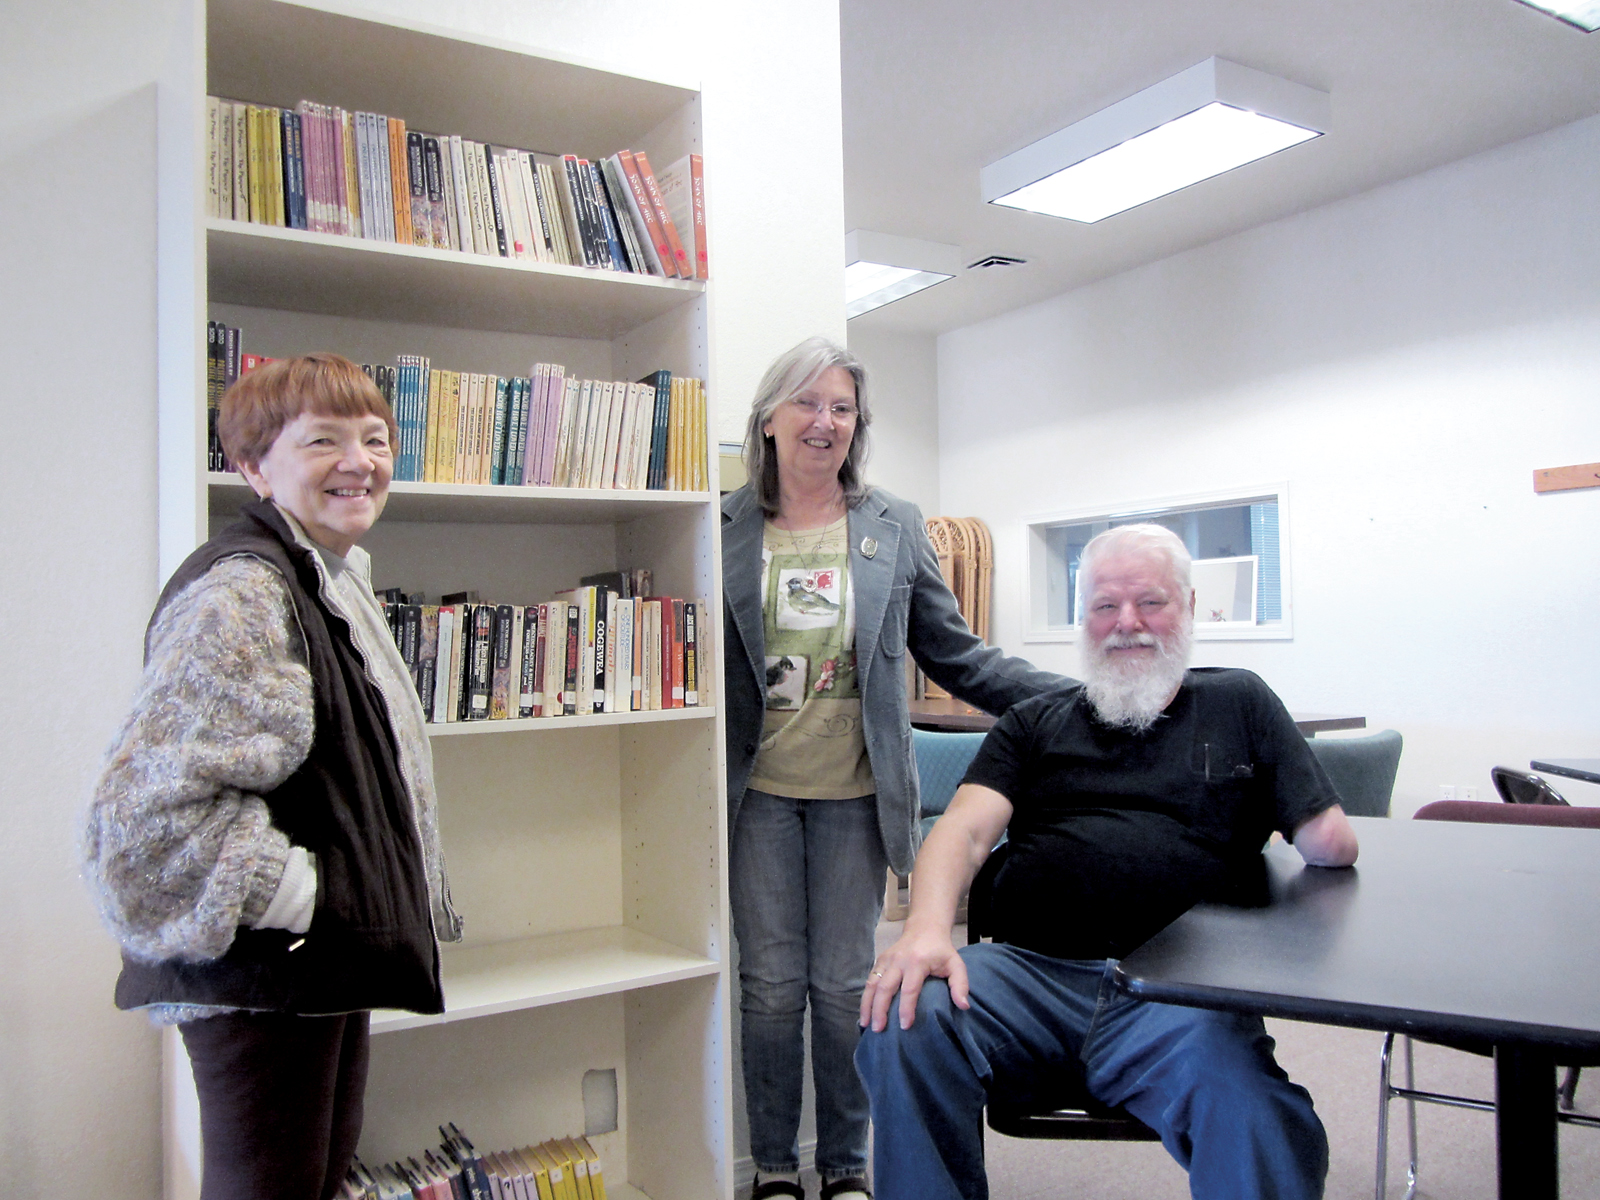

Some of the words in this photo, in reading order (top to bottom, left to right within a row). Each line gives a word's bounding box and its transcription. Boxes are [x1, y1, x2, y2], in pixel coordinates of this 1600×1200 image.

[629, 174, 641, 194] JOAN
[638, 196, 646, 205] OF
[644, 208, 653, 223] ARC
[645, 176, 656, 196] JOAN
[654, 198, 662, 206] OF
[659, 210, 669, 224] ARC
[696, 198, 702, 208] OF
[518, 431, 526, 451] LOVED
[596, 621, 604, 675] COGEWEA
